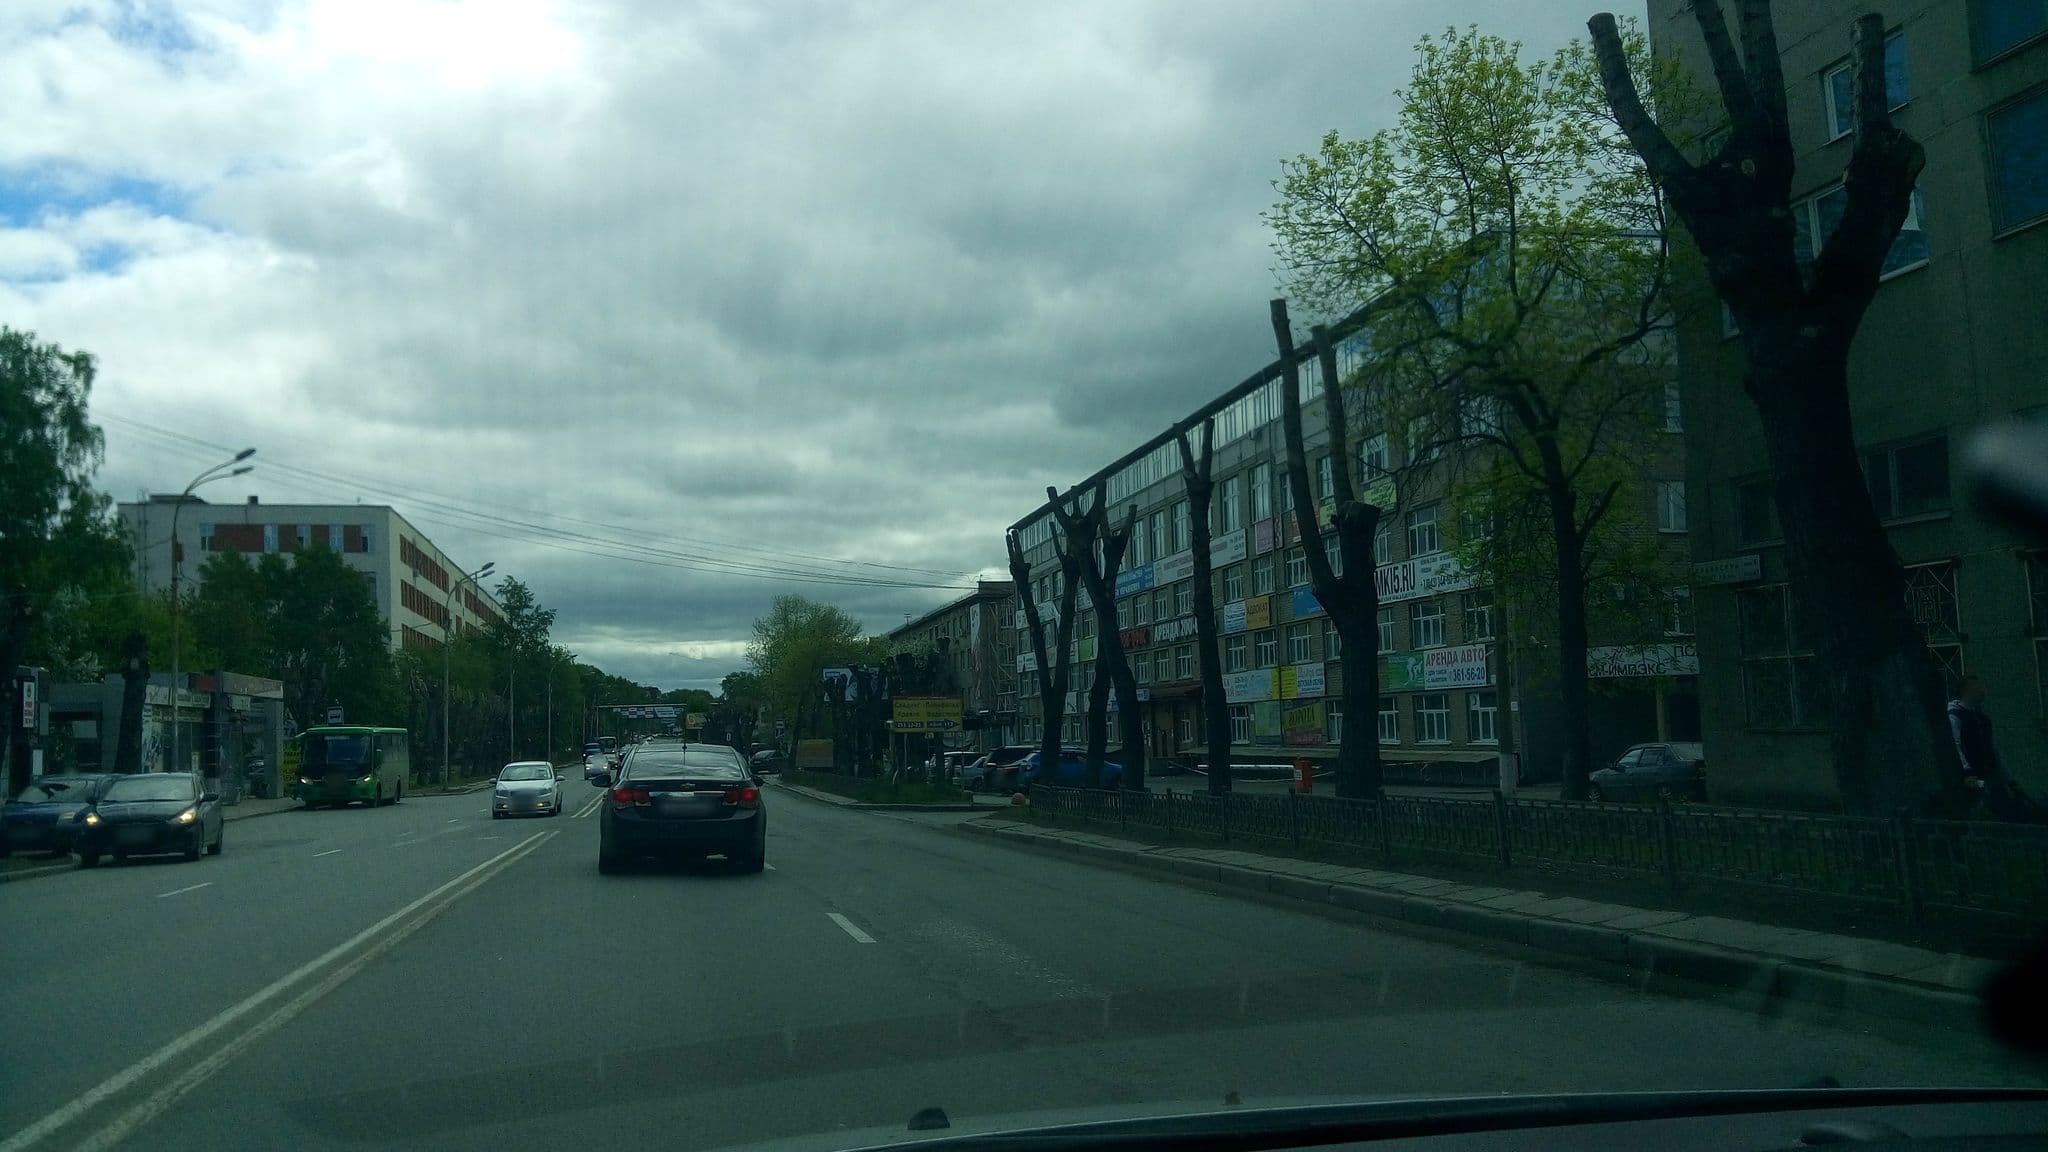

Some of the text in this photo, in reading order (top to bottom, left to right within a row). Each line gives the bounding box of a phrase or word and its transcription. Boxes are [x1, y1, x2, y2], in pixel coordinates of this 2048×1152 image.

[1154, 621, 1180, 642] АРЕНДА
[1425, 648, 1485, 667] АРЕНДА АВТО
[1453, 667, 1485, 681] 361-56-20
